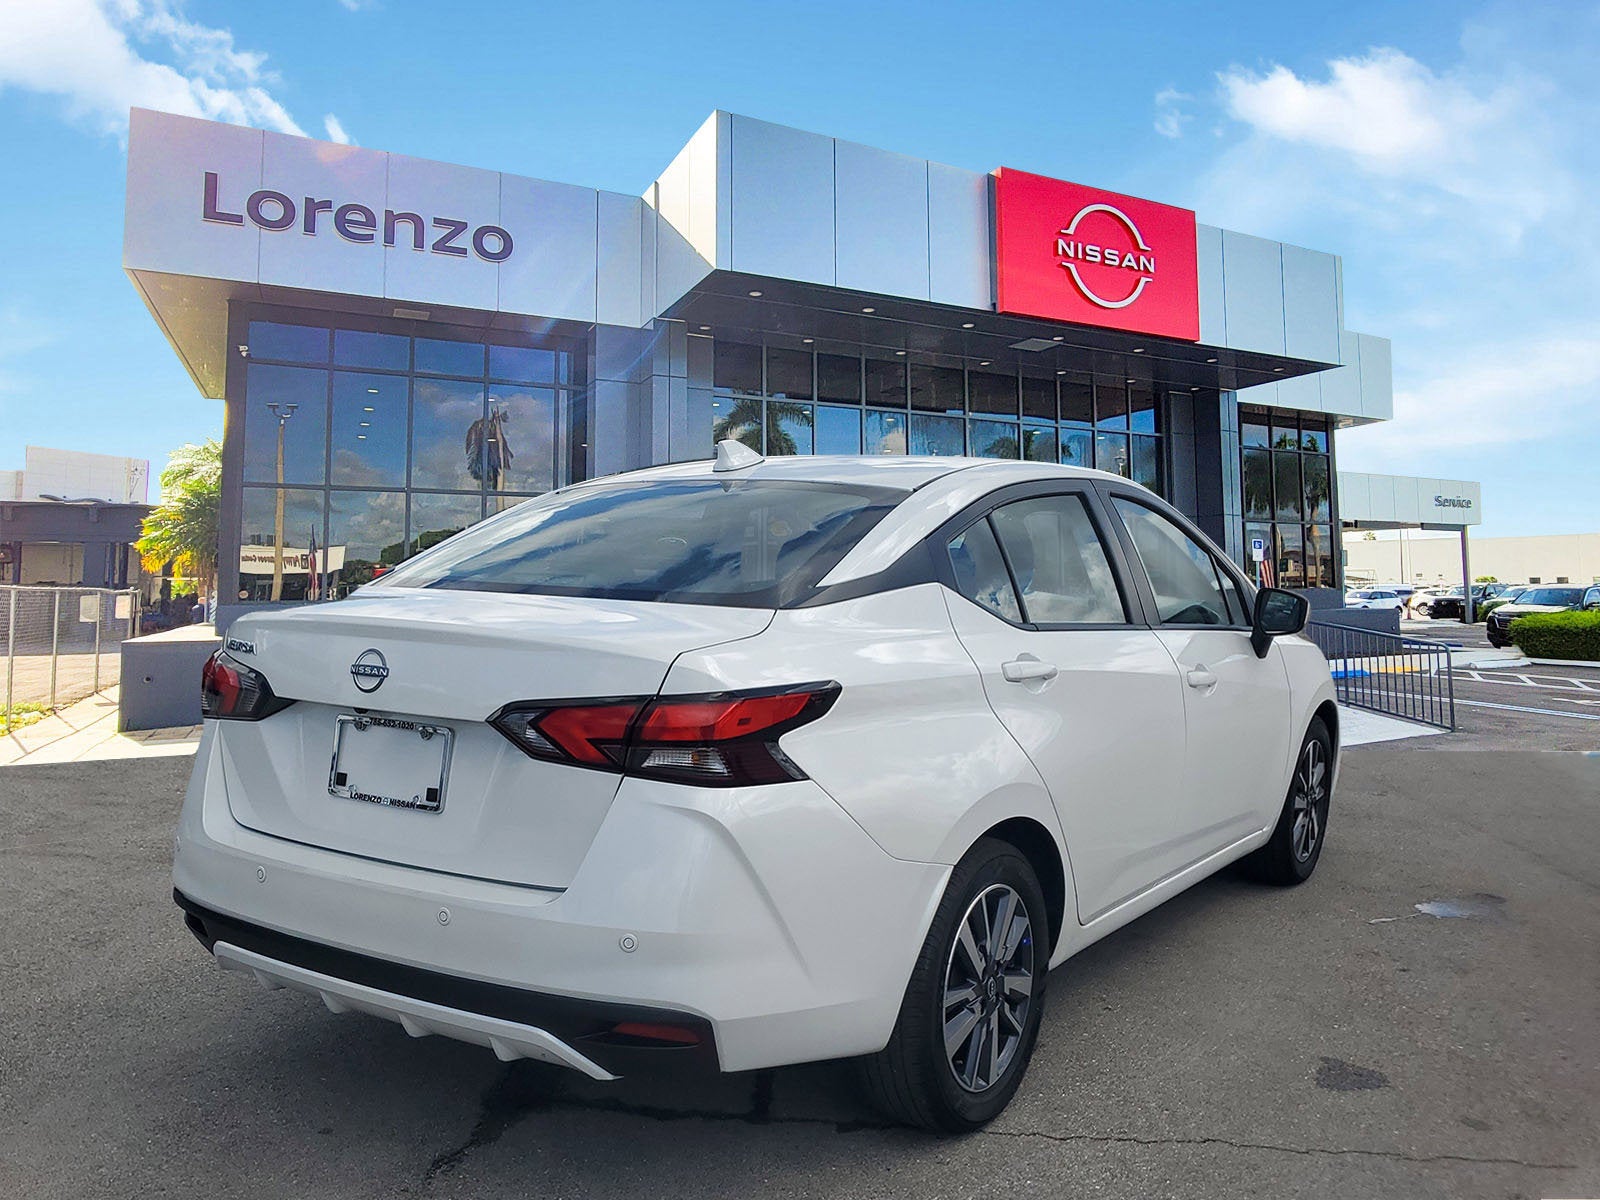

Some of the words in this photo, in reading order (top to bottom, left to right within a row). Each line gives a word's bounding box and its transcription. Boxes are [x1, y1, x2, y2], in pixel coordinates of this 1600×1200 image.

[203, 171, 513, 262] Lorenzo
[1057, 238, 1155, 273] NISSAN
[1434, 495, 1472, 509] Service
[351, 664, 389, 677] NISSAN
[350, 791, 382, 804] LORENZO
[390, 799, 416, 809] NISSAN
